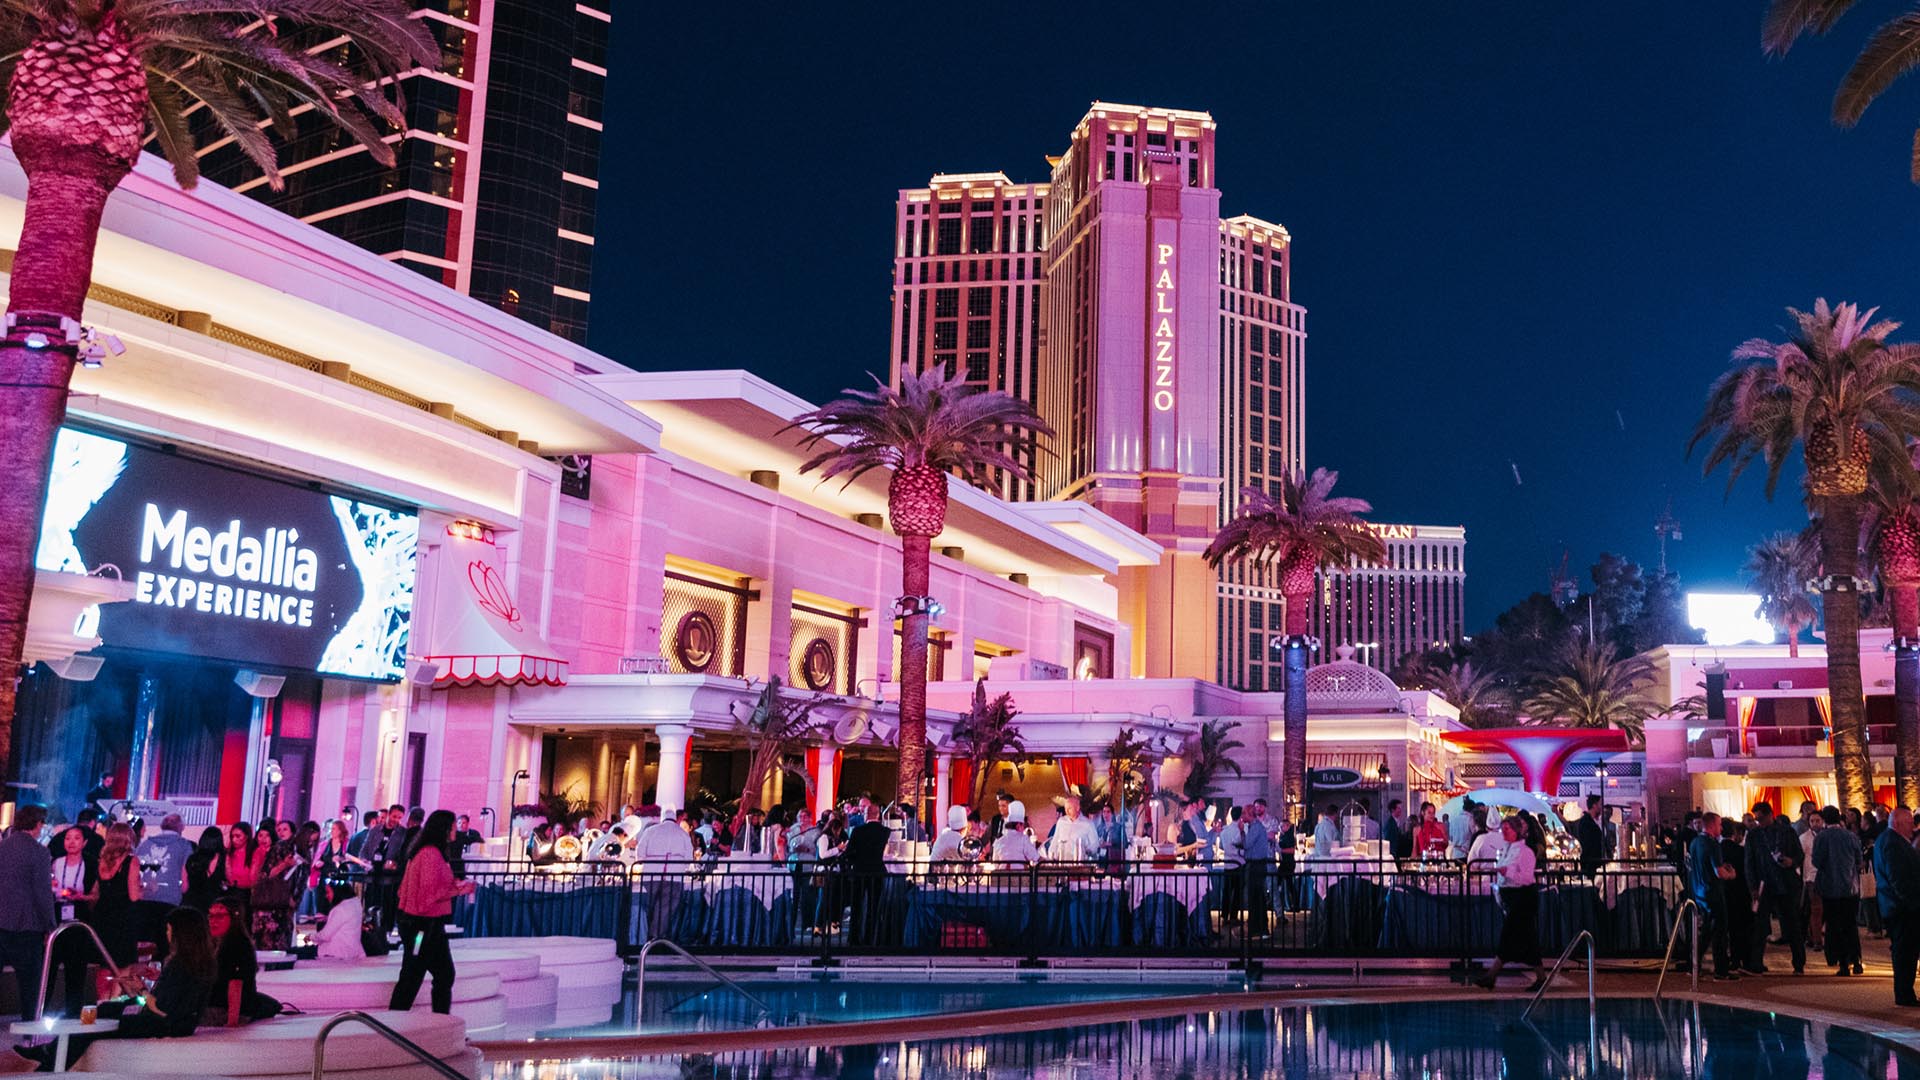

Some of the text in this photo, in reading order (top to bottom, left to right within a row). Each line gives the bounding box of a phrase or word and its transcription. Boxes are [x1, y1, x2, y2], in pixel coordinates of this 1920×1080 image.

[1154, 244, 1174, 411] PALAZZO
[140, 503, 317, 592] Medallia
[136, 571, 314, 627] EXPERIENCE
